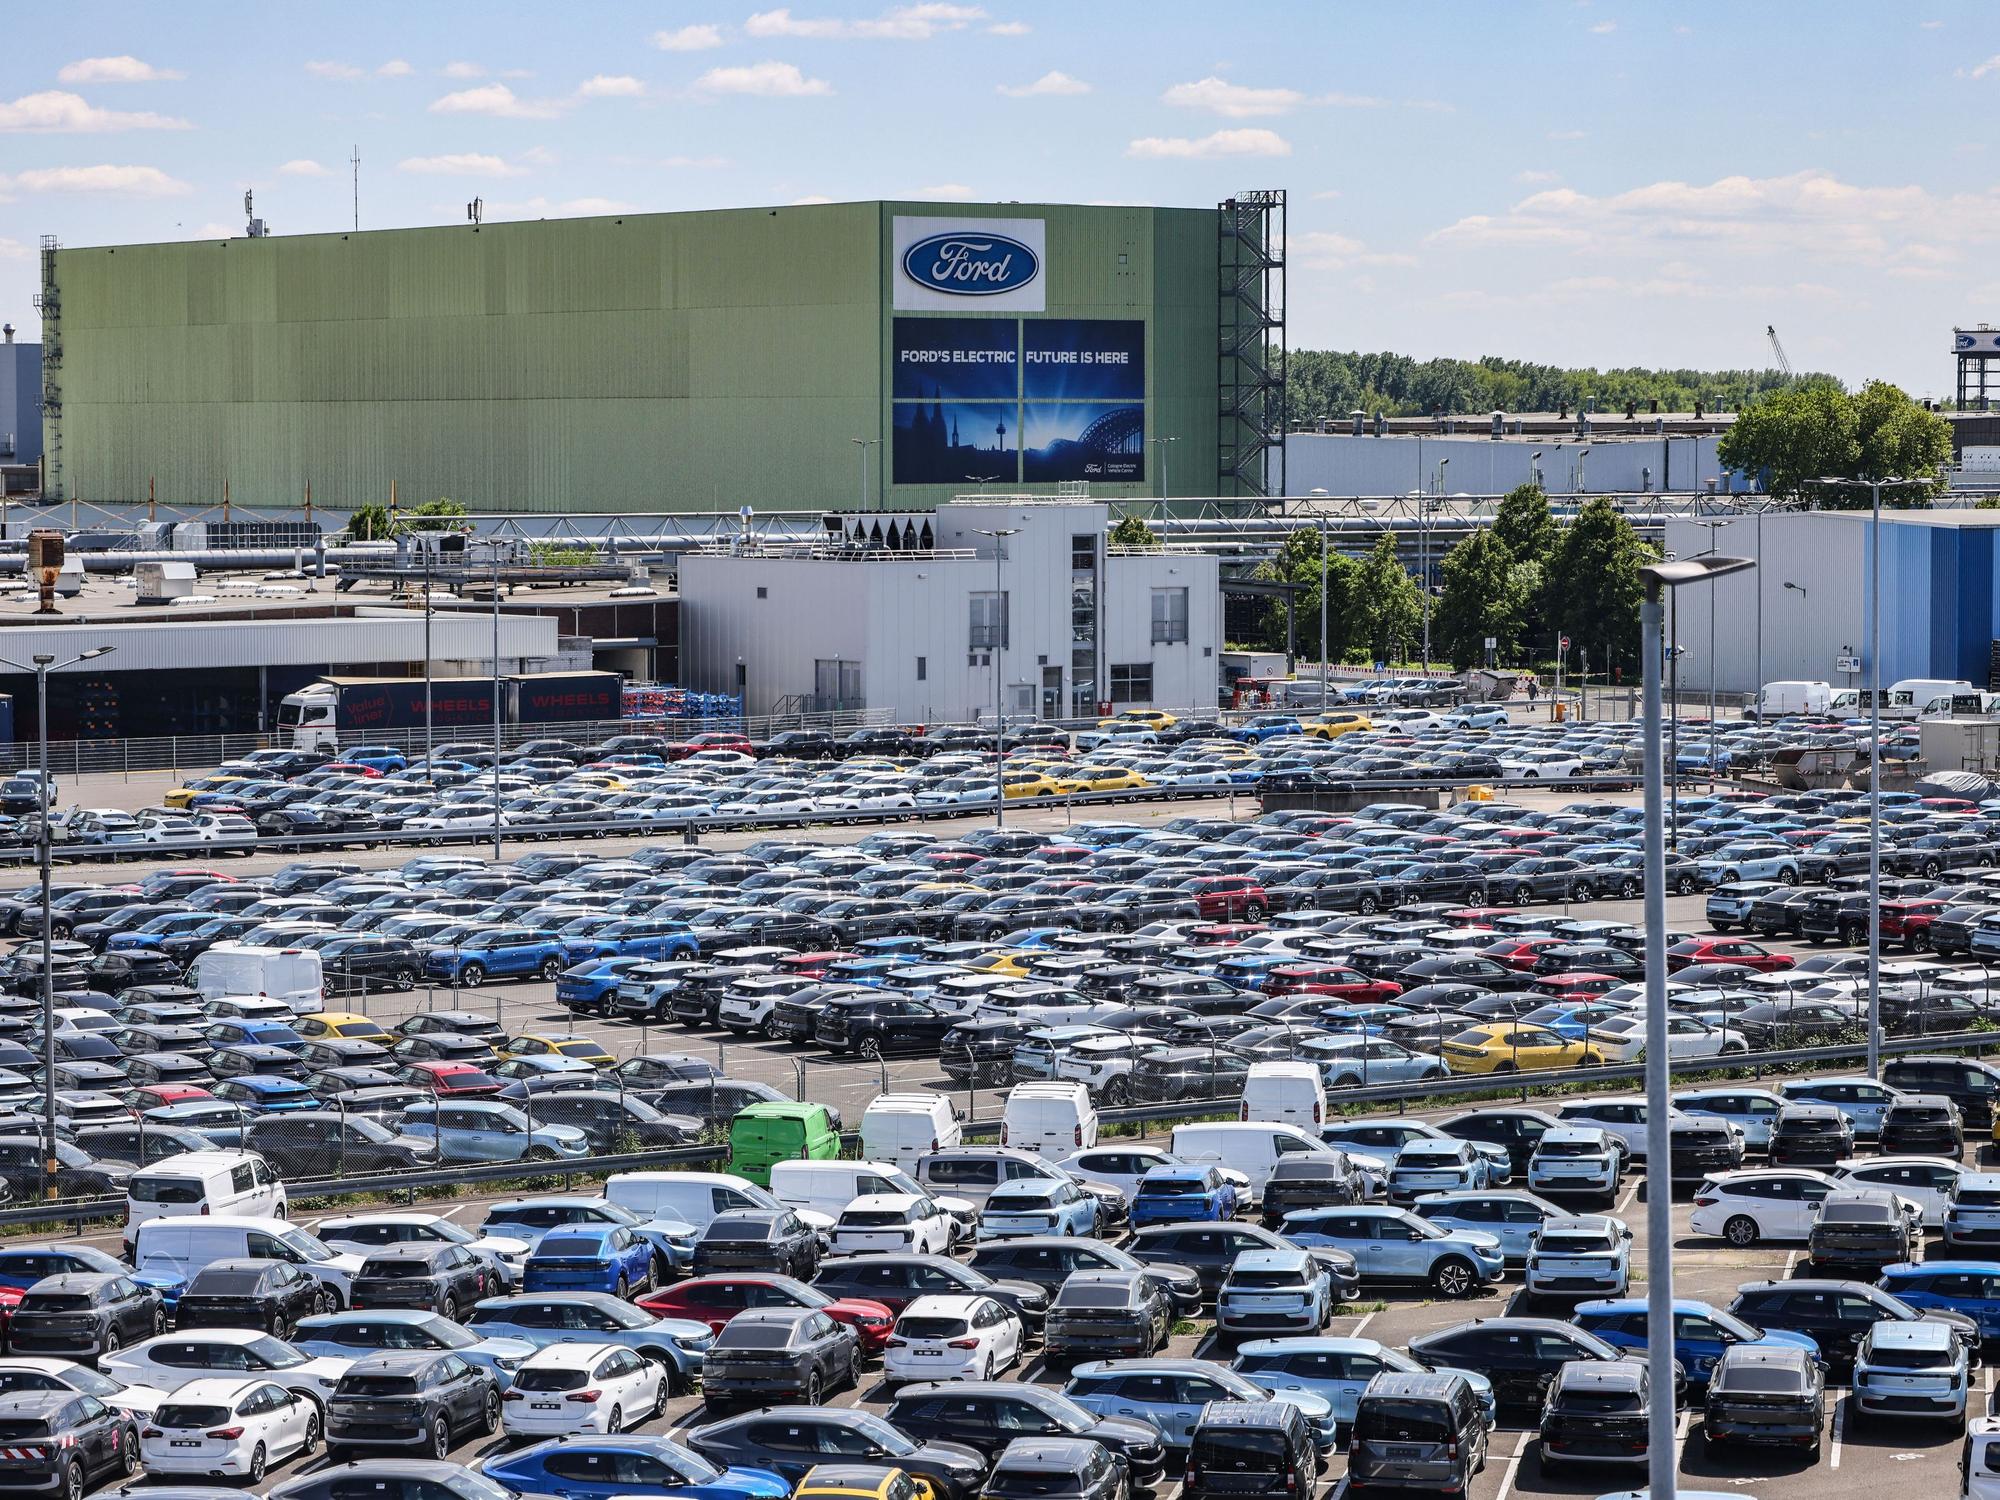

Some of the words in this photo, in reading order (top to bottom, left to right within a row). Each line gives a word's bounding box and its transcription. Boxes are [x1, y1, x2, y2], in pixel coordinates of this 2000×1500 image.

[932, 242, 1012, 282] Ford
[901, 350, 951, 363] FORD'S
[953, 350, 1016, 363] ELECTRIC
[1026, 351, 1078, 364] FUTURE
[1080, 351, 1094, 364] IS
[1095, 351, 1129, 364] HERE
[346, 696, 385, 715] Value
[410, 698, 489, 713] WHEELS
[531, 692, 609, 707] WHEELS
